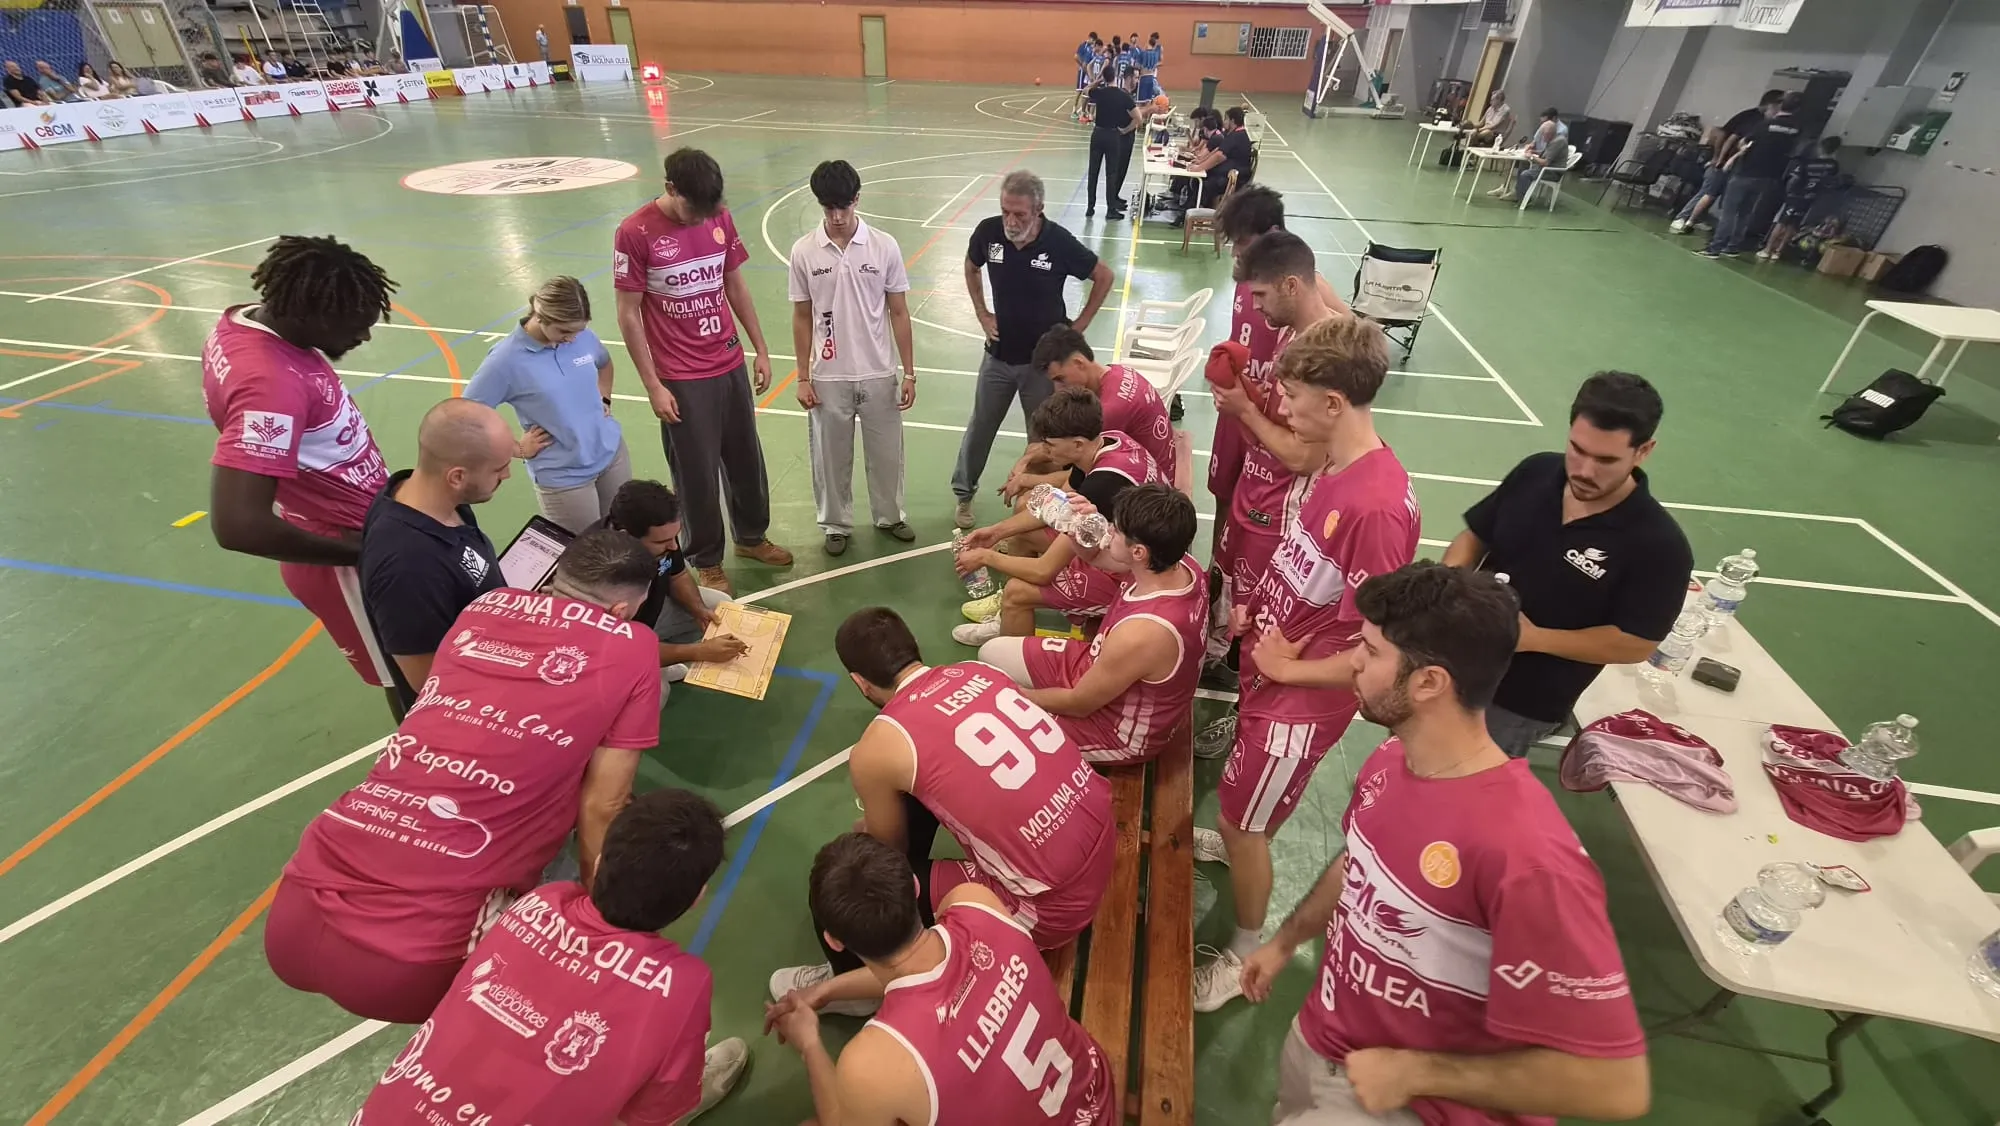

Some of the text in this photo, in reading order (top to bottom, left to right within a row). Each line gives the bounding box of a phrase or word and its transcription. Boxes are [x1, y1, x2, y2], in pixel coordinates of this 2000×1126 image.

[403, 80, 424, 88] ESTEVA
[35, 123, 76, 137] CBCM
[665, 265, 715, 287] CBCM
[662, 296, 713, 314] MOLINA
[699, 316, 721, 336] 20
[1240, 322, 1252, 346] 8
[208, 344, 232, 385] OLEA
[1246, 461, 1273, 484] OLEA
[1566, 549, 1607, 579] CBCM
[474, 591, 634, 640] MOLINA OLEA
[478, 641, 535, 661] deportes
[933, 674, 993, 716] LESME
[443, 711, 524, 741] LA COCINA DE ROSA
[479, 703, 506, 724] en
[517, 713, 574, 748] Casa
[954, 687, 1066, 790] 99
[1018, 782, 1075, 842] MOLINA
[1031, 786, 1092, 849] INMOBILIARIA
[365, 823, 448, 855] BETTER IN GREEN
[498, 912, 601, 984] INMOBILIARIA
[508, 892, 673, 998] MOLINA OLEA
[1320, 965, 1336, 1012] 6
[1349, 951, 1431, 1018] OLEA
[488, 983, 549, 1029] deportes
[956, 954, 1029, 1073] LLABRÉS
[1001, 1001, 1073, 1118] 5
[414, 1099, 427, 1114] LA
[456, 1103, 493, 1126] en
